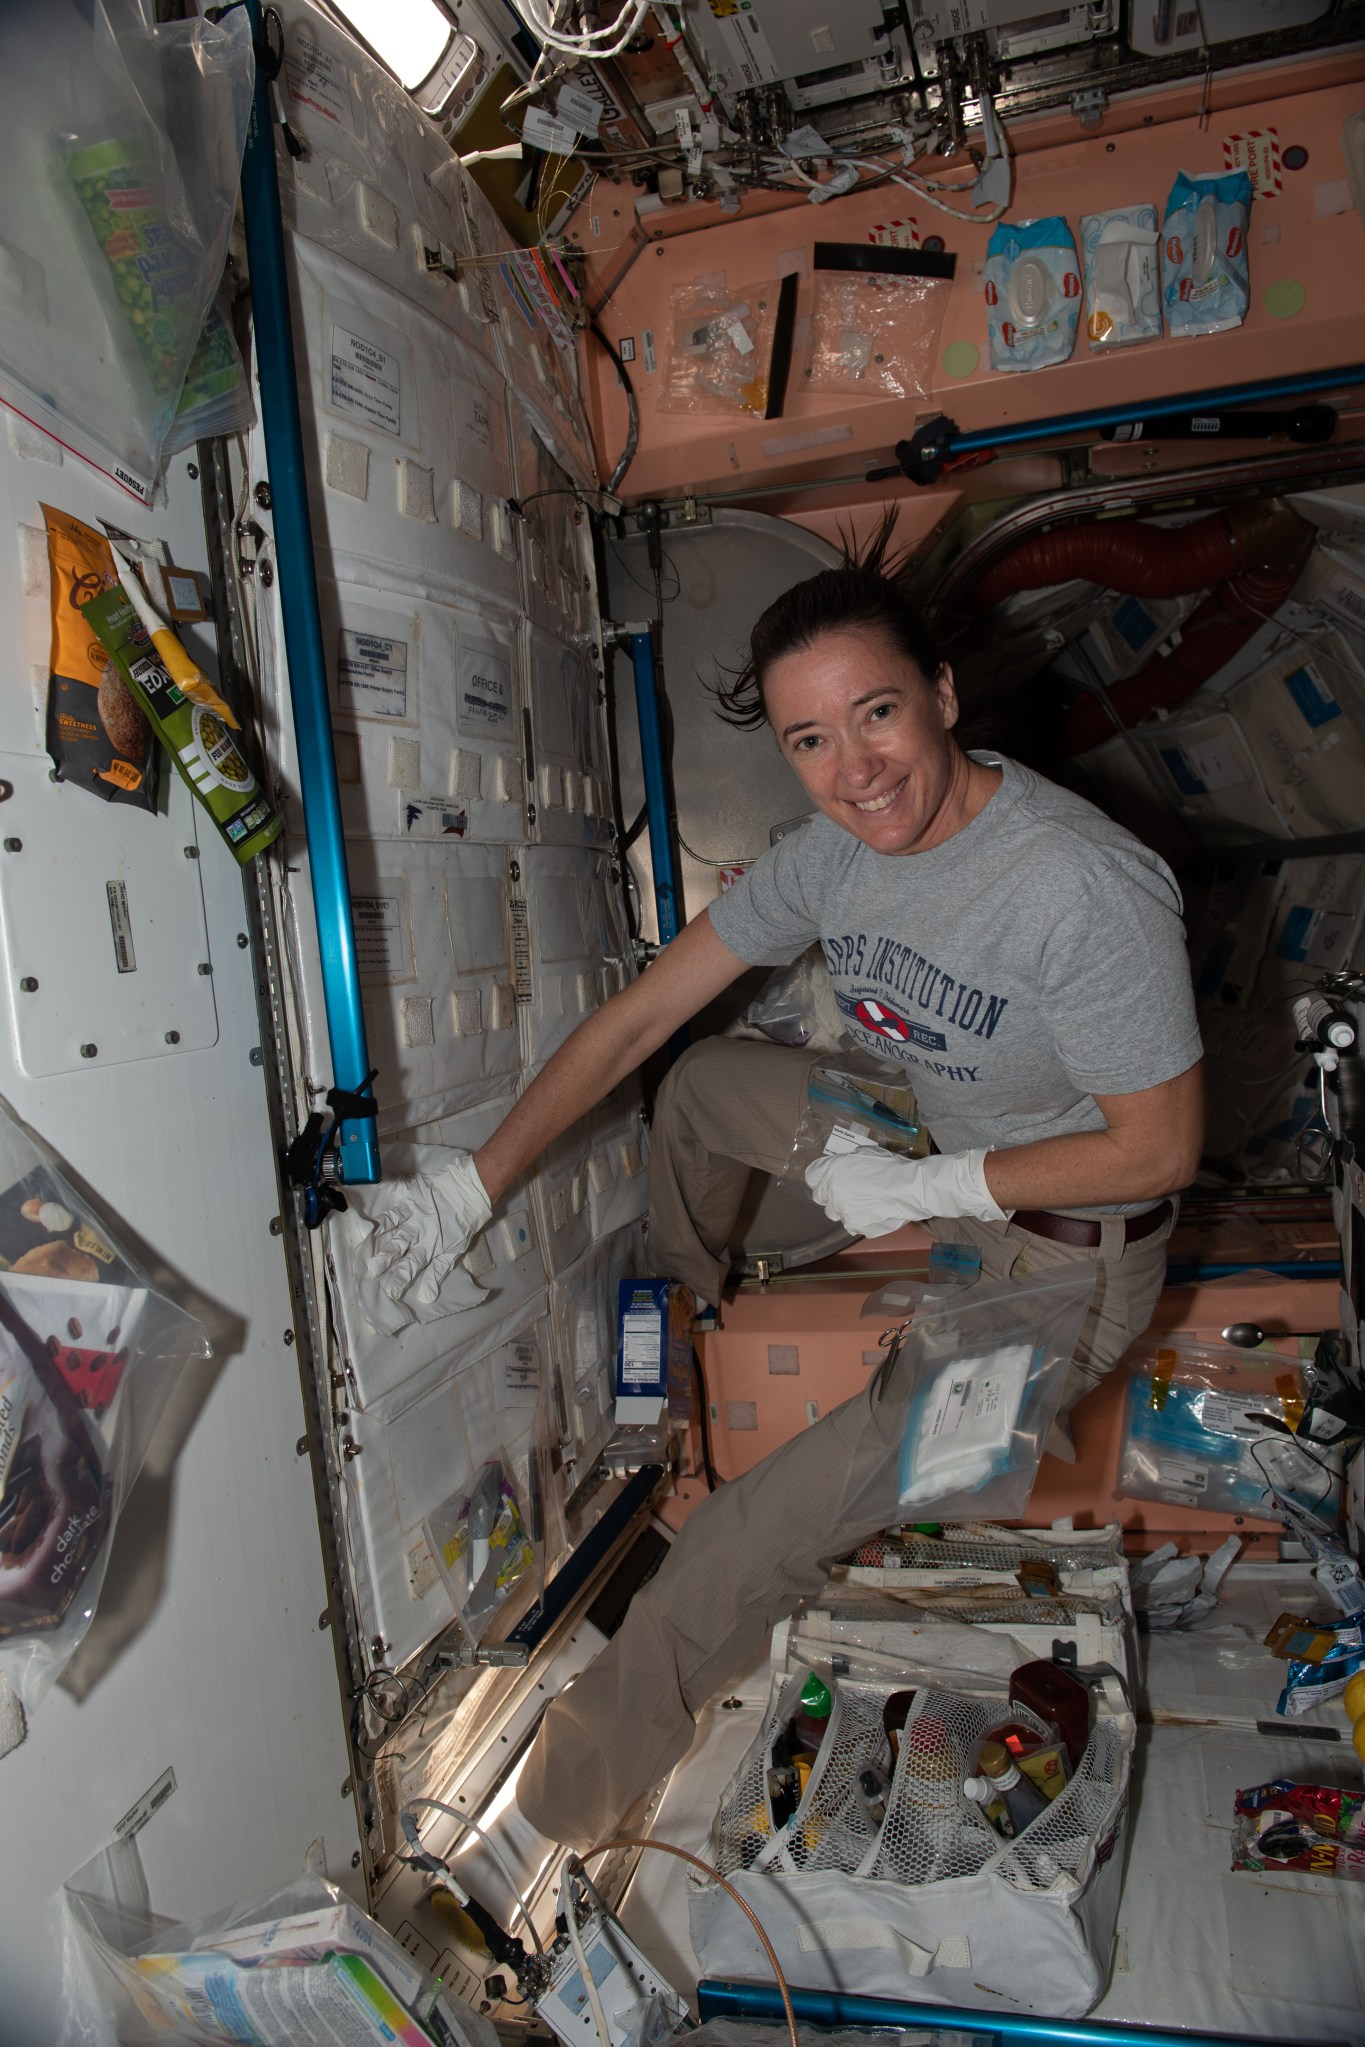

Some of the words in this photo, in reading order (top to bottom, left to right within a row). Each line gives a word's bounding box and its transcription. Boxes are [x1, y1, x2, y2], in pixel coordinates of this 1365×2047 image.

[740, 62, 756, 84] FRIDGE
[574, 68, 620, 121] GALLEY
[1248, 140, 1257, 167] PORT
[890, 230, 899, 248] ORT
[114, 468, 144, 496] PESQUET
[472, 675, 498, 693] OFFICE
[499, 684, 504, 695] &
[59, 720, 97, 730] SWEETNESS
[866, 936, 1008, 1040] INSTITUTION
[913, 1030, 941, 1048] REC.
[1230, 1399, 1252, 1408] Sampling
[50, 1504, 98, 1584] chocolate
[56, 1514, 82, 1554] dark
[440, 1963, 451, 1979] GENERAL
